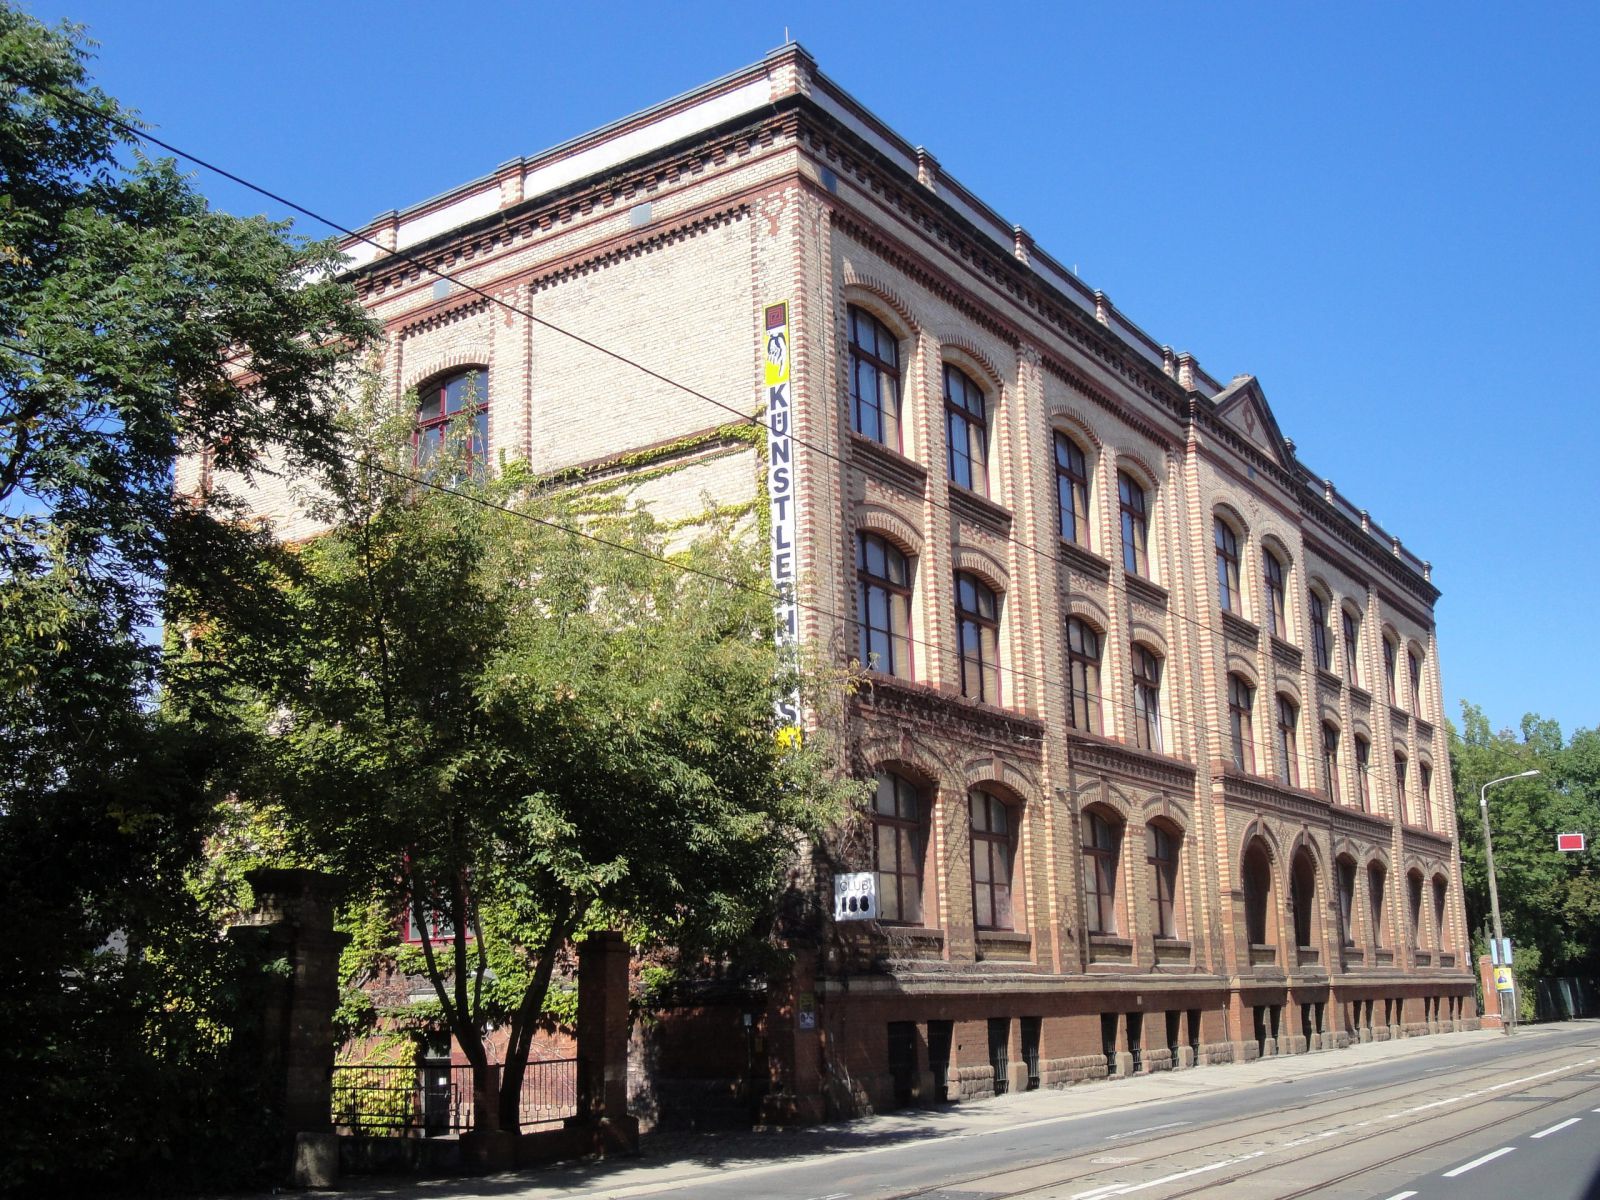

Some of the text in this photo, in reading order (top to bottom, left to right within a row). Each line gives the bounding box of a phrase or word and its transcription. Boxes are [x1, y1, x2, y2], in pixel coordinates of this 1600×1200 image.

[769, 383, 798, 726] KÜNSTLERHS
[839, 880, 869, 892] CLUB
[841, 895, 870, 913] 188
